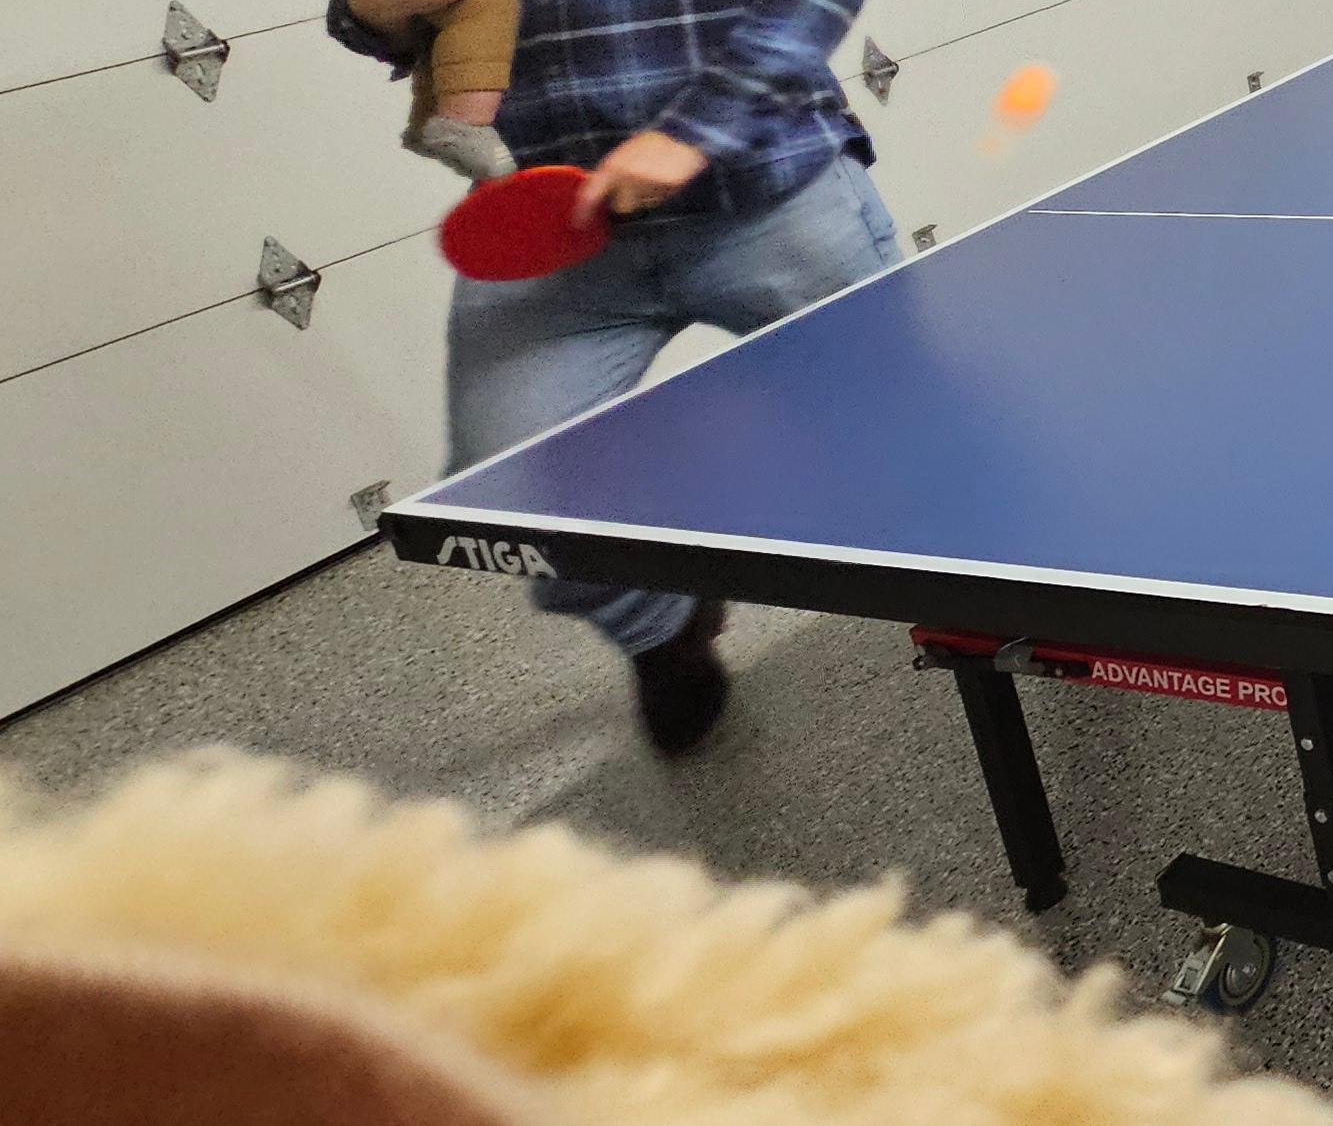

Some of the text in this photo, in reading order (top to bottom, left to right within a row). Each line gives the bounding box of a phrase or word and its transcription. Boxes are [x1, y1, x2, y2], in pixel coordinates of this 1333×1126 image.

[436, 535, 558, 579] STIGA
[1091, 660, 1288, 707] ADVANTAGE PRO
